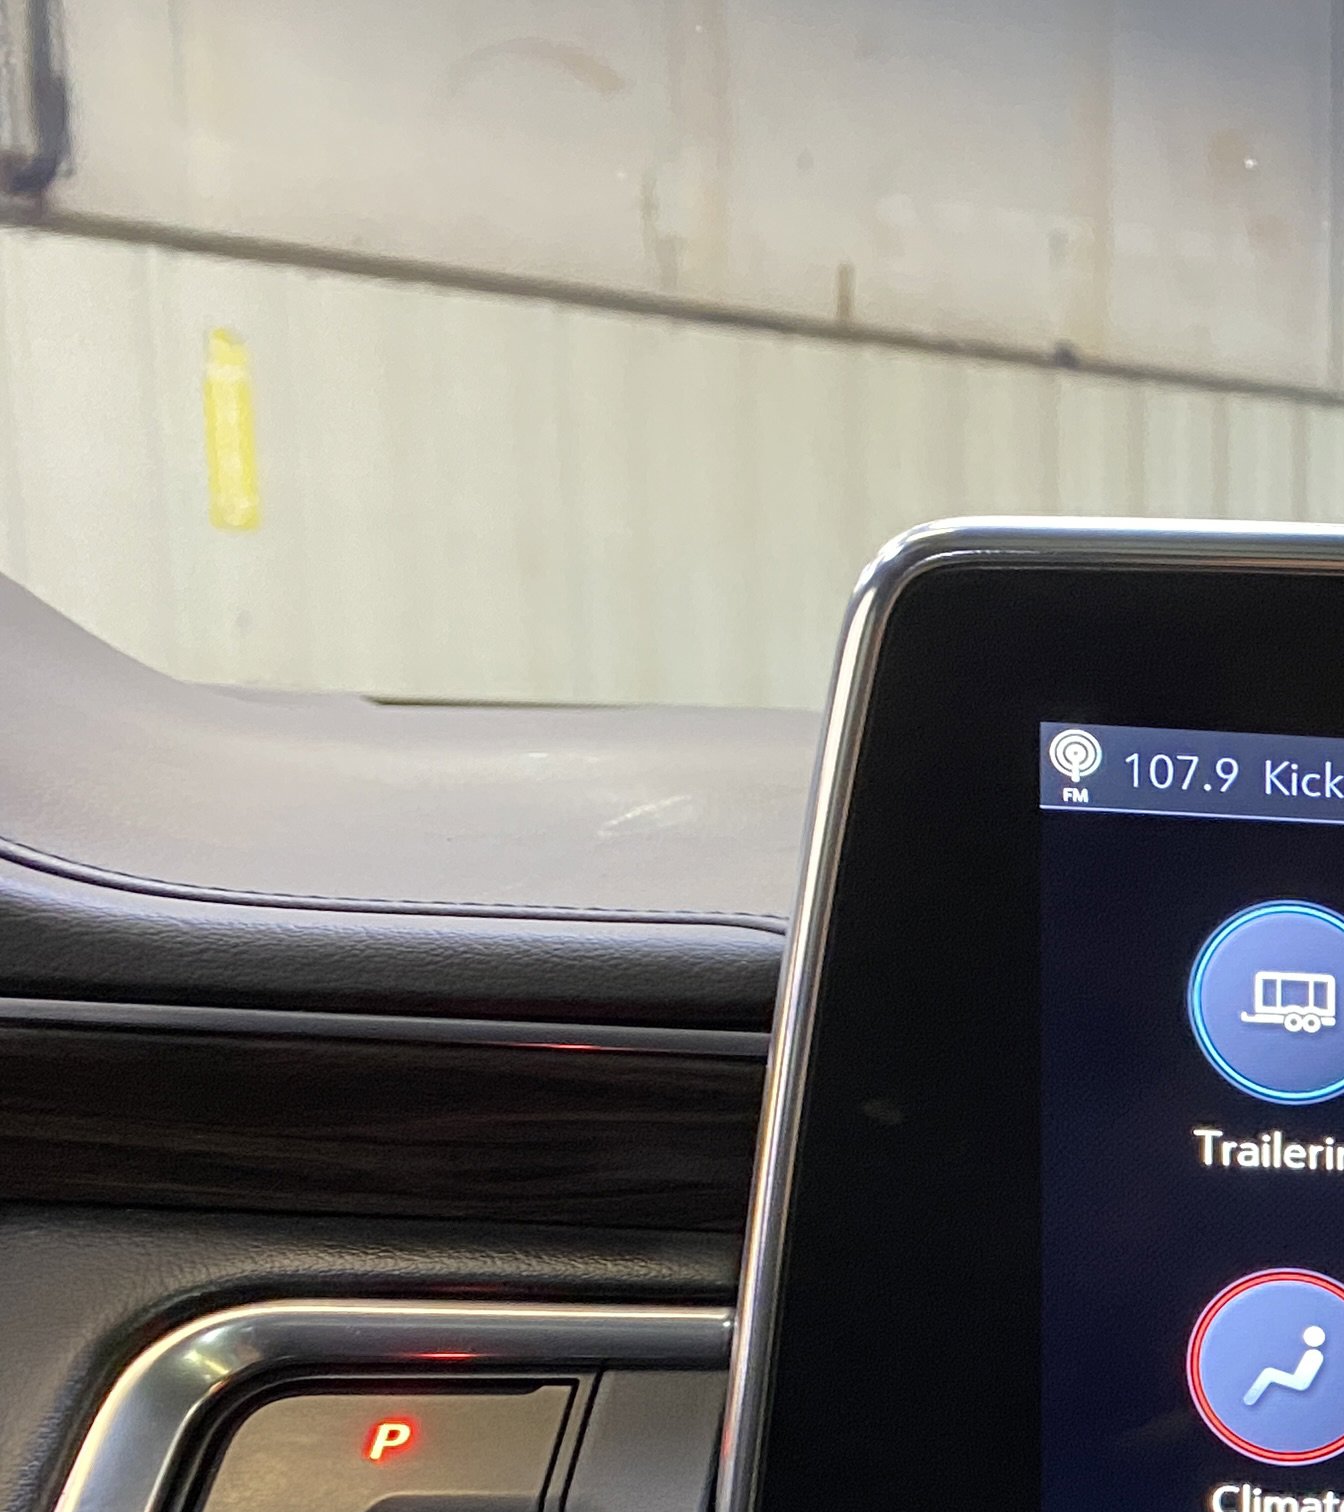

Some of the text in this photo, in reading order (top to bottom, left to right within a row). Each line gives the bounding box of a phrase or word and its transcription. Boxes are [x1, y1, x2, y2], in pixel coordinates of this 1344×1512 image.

[1124, 752, 1240, 793] 107.9
[1062, 787, 1090, 804] FM
[368, 1420, 411, 1461] P
